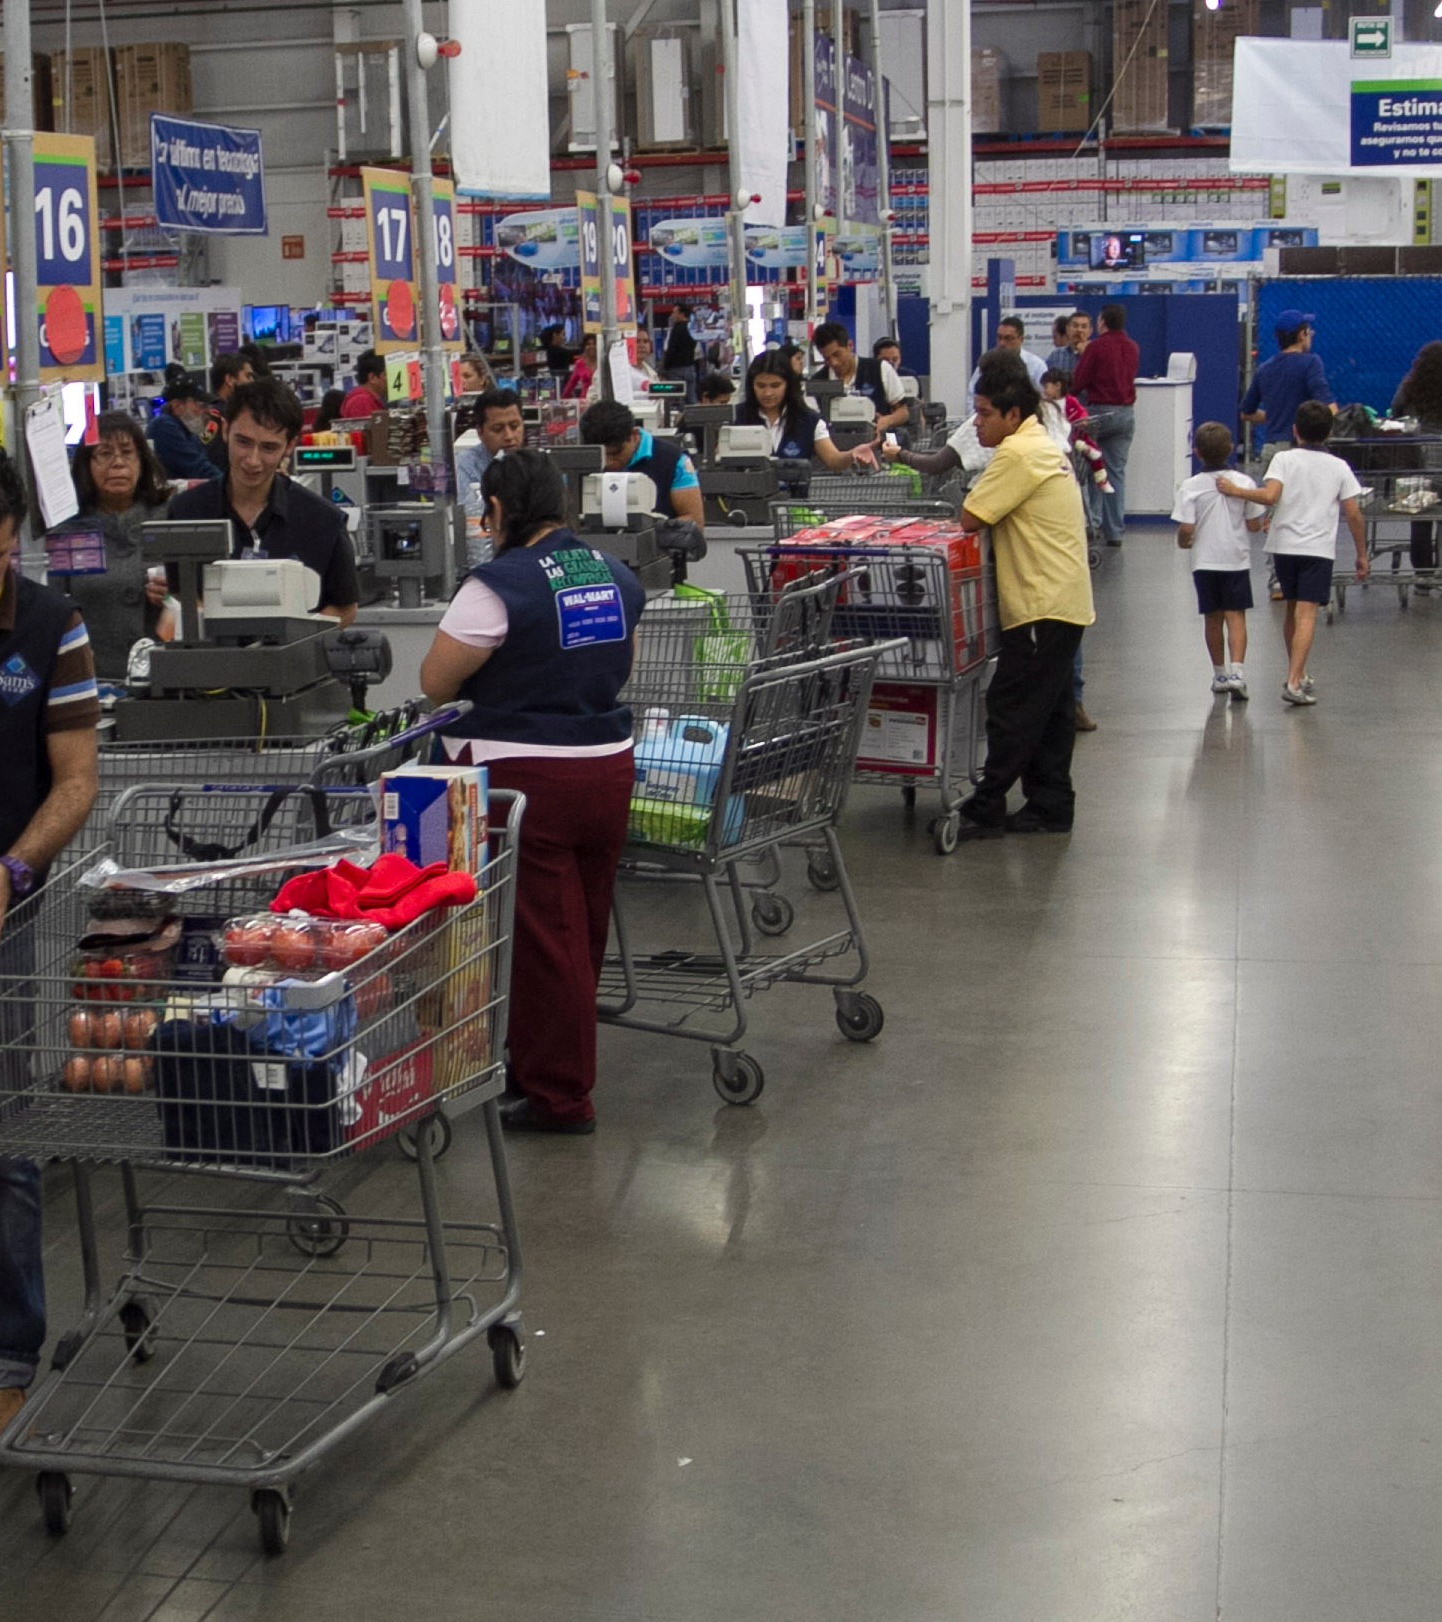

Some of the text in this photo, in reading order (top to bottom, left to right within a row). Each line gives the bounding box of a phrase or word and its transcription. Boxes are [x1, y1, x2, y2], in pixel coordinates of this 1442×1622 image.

[1373, 121, 1431, 133] Revisamos
[1360, 135, 1425, 147] aseguramos
[1393, 149, 1401, 159] y
[1402, 148, 1417, 157] no
[1419, 147, 1430, 157] te
[35, 187, 86, 263] 16
[377, 207, 407, 263] 17
[583, 221, 597, 263] 19
[393, 370, 402, 392] 4
[539, 556, 555, 568] LA
[545, 566, 564, 579] LAS
